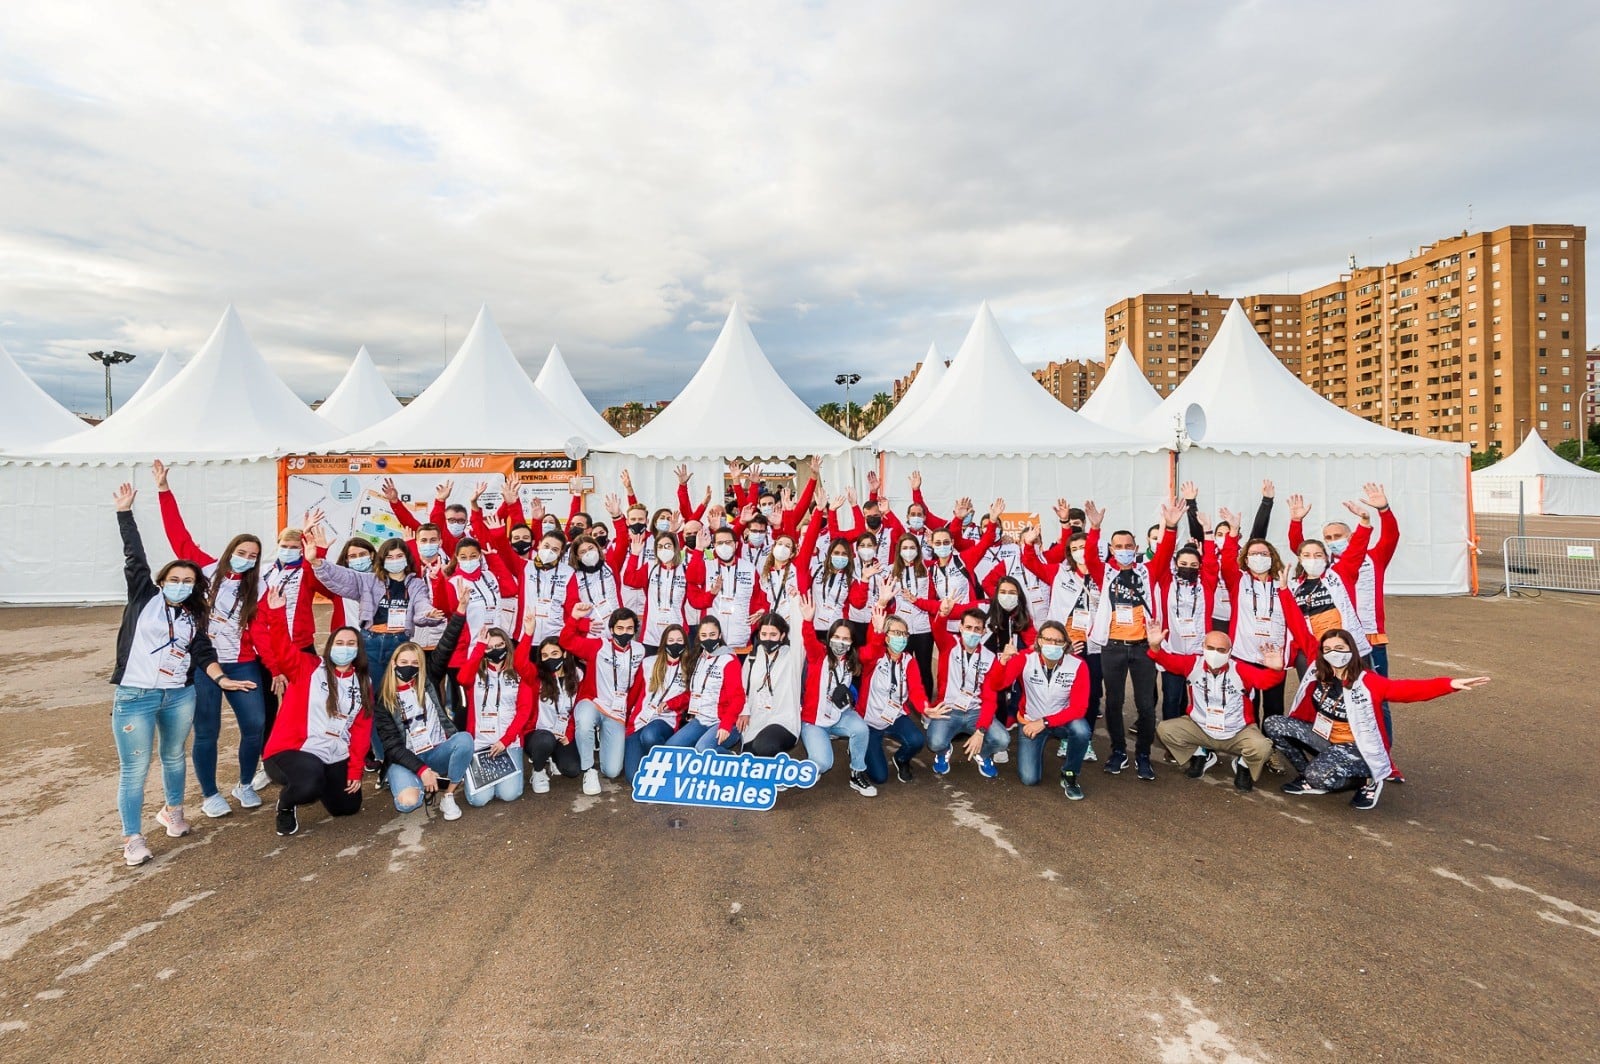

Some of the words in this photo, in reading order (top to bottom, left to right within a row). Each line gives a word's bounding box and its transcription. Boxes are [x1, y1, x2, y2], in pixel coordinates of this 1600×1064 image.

[413, 458, 451, 469] SALIDA
[460, 457, 485, 468] START
[519, 460, 572, 469] 24-OCT-2021
[1002, 520, 1034, 531] OLSA
[676, 752, 813, 783] Voluntarios
[674, 776, 772, 805] Vithales
